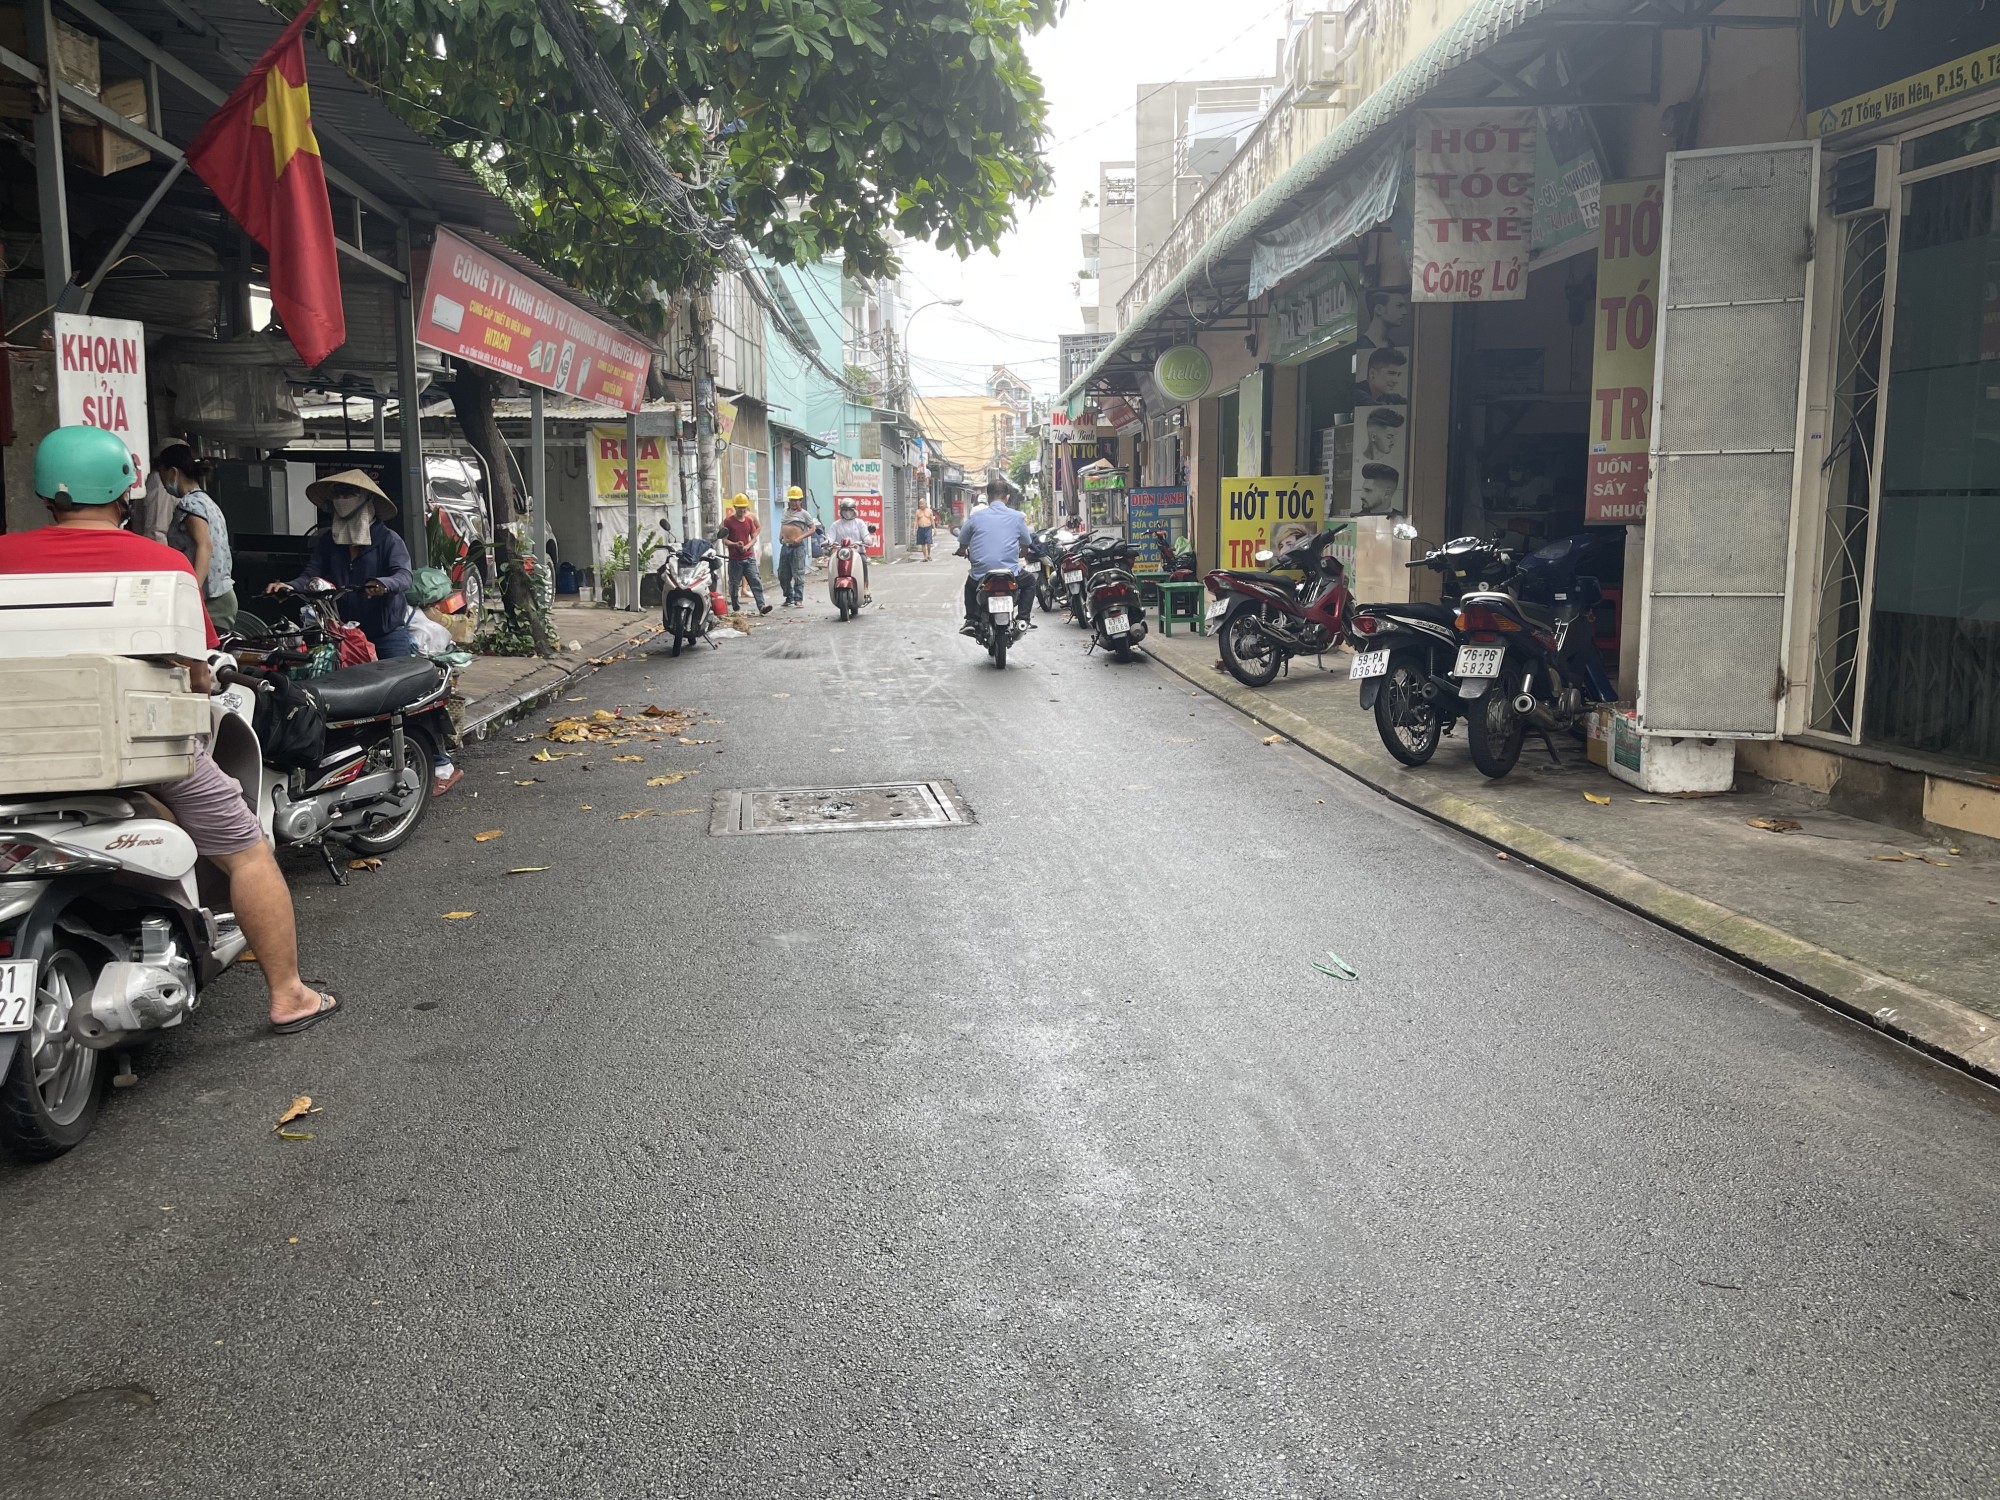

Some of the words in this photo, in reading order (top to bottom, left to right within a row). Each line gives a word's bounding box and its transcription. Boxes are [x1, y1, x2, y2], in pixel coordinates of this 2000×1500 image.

[1841, 106, 1854, 127] 27
[1856, 98, 1882, 121] Tống
[1884, 91, 1905, 112] Văn
[1908, 82, 1933, 104] Hên,
[1936, 66, 1968, 95] P.15,
[1431, 121, 1530, 154] HỚT
[1432, 167, 1528, 198] TÓC
[1427, 207, 1522, 243] TRẺ
[453, 254, 489, 293] CÔNG
[491, 274, 506, 300] TY
[506, 282, 535, 316] TNHH
[1422, 257, 1486, 298] Cống
[61, 333, 138, 375] KHOAN
[484, 326, 512, 353] HITACHI
[1166, 362, 1202, 381] hello
[1595, 386, 1651, 441] TR
[1597, 456, 1632, 475] UỐN
[1593, 477, 1627, 496] SẤY
[1230, 483, 1269, 521] HỚT
[1275, 482, 1315, 519] TÓC
[1600, 501, 1647, 518] NHUỘ
[1357, 652, 1384, 667] 59-PA
[1461, 662, 1493, 675] 5823
[1465, 649, 1497, 662] 76-P6
[105, 833, 141, 850] SH
